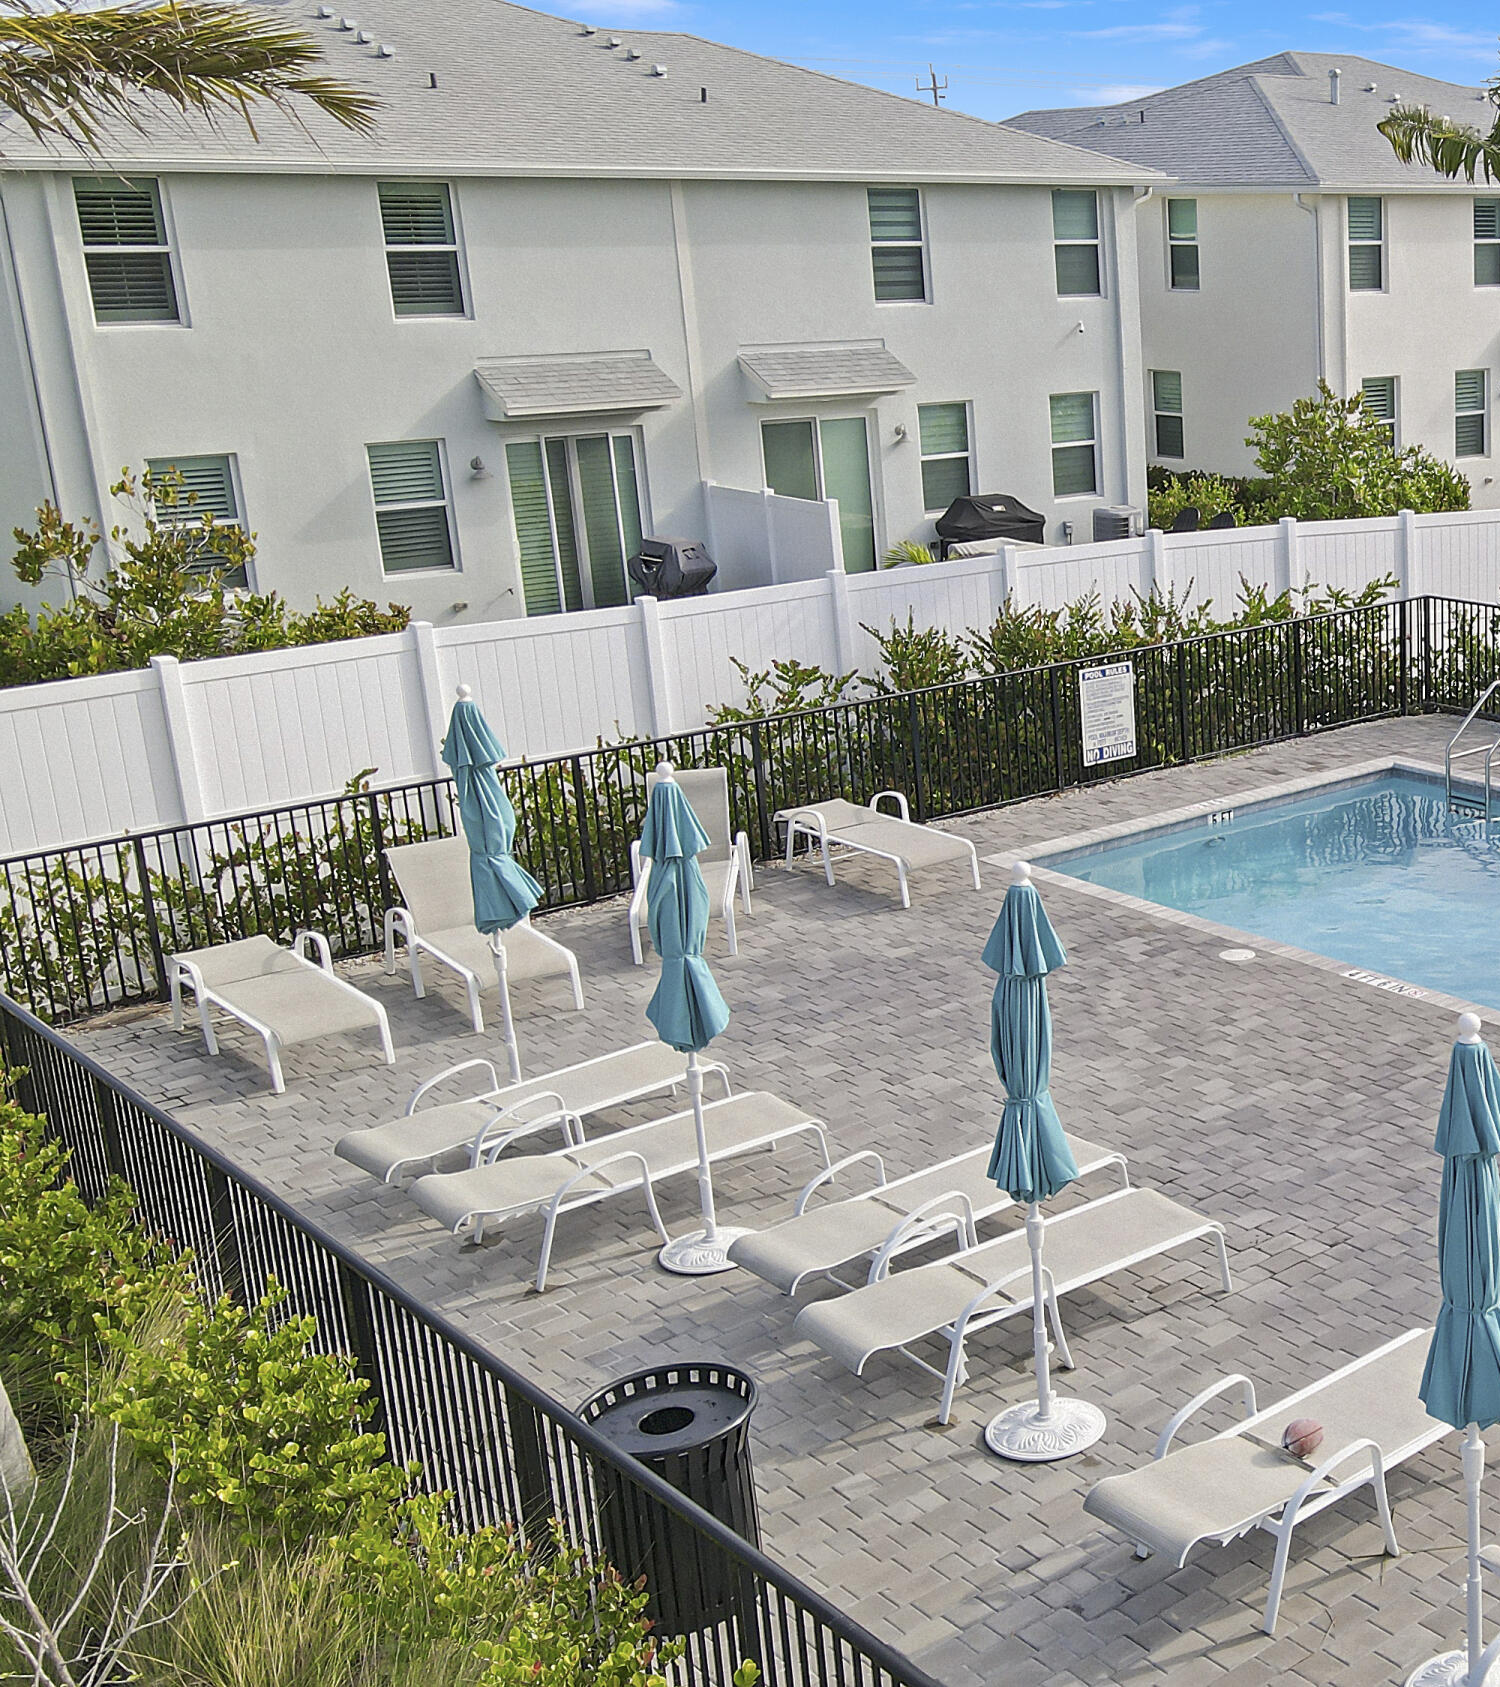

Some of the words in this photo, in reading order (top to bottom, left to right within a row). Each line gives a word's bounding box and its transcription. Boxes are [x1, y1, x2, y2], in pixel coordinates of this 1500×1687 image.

[1087, 749, 1100, 762] NO
[1103, 742, 1134, 758] DIVING
[1221, 810, 1233, 824] FT
[1388, 984, 1411, 993] IN
